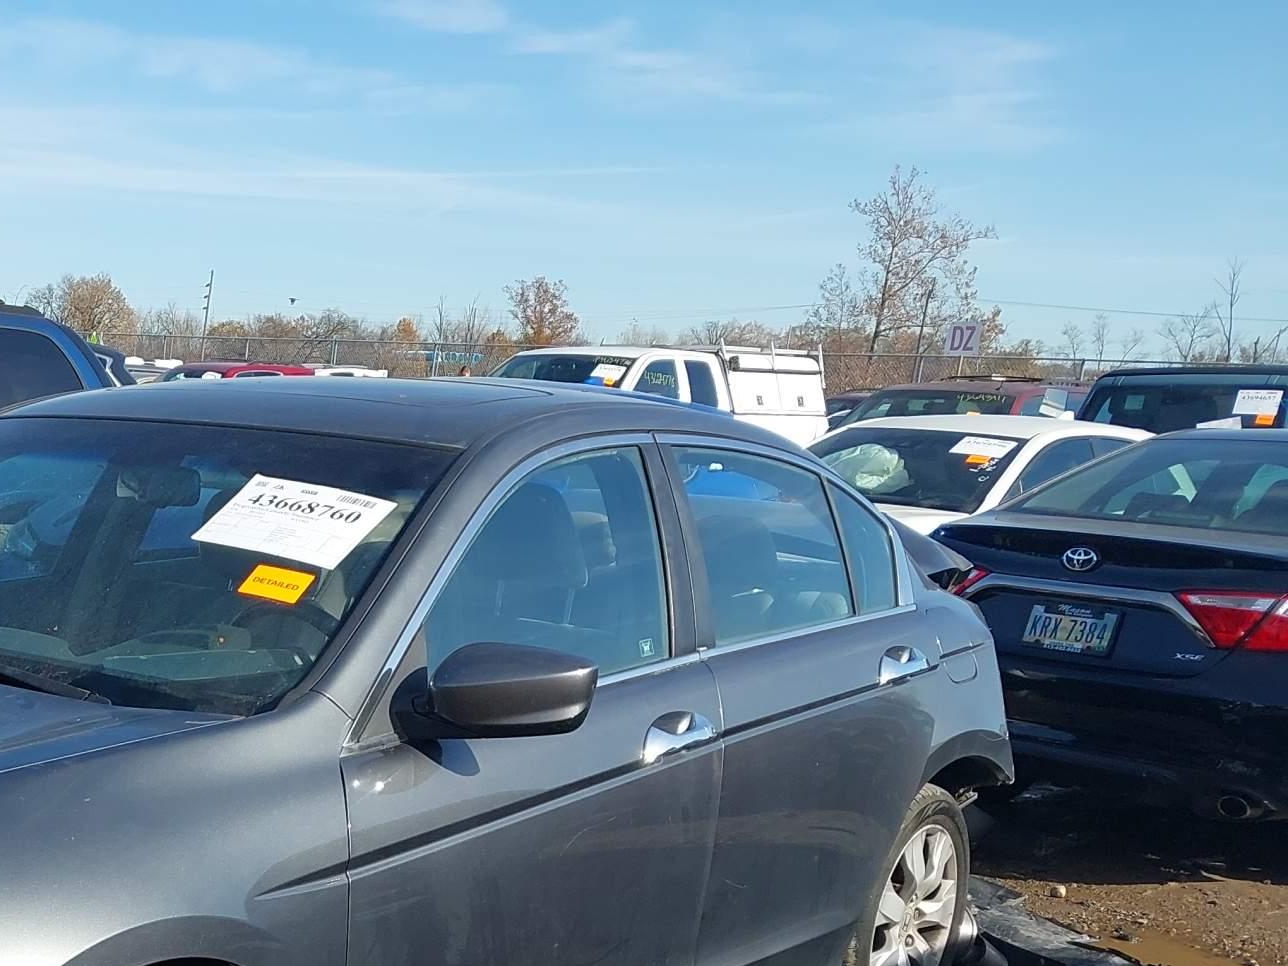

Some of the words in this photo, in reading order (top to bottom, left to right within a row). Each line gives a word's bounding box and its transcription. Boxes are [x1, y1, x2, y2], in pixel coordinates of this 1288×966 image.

[950, 325, 976, 351] DZ
[248, 492, 362, 524] 43668760
[252, 575, 300, 592] DETAILED
[1028, 614, 1063, 640] KRX
[1065, 619, 1108, 645] 7384
